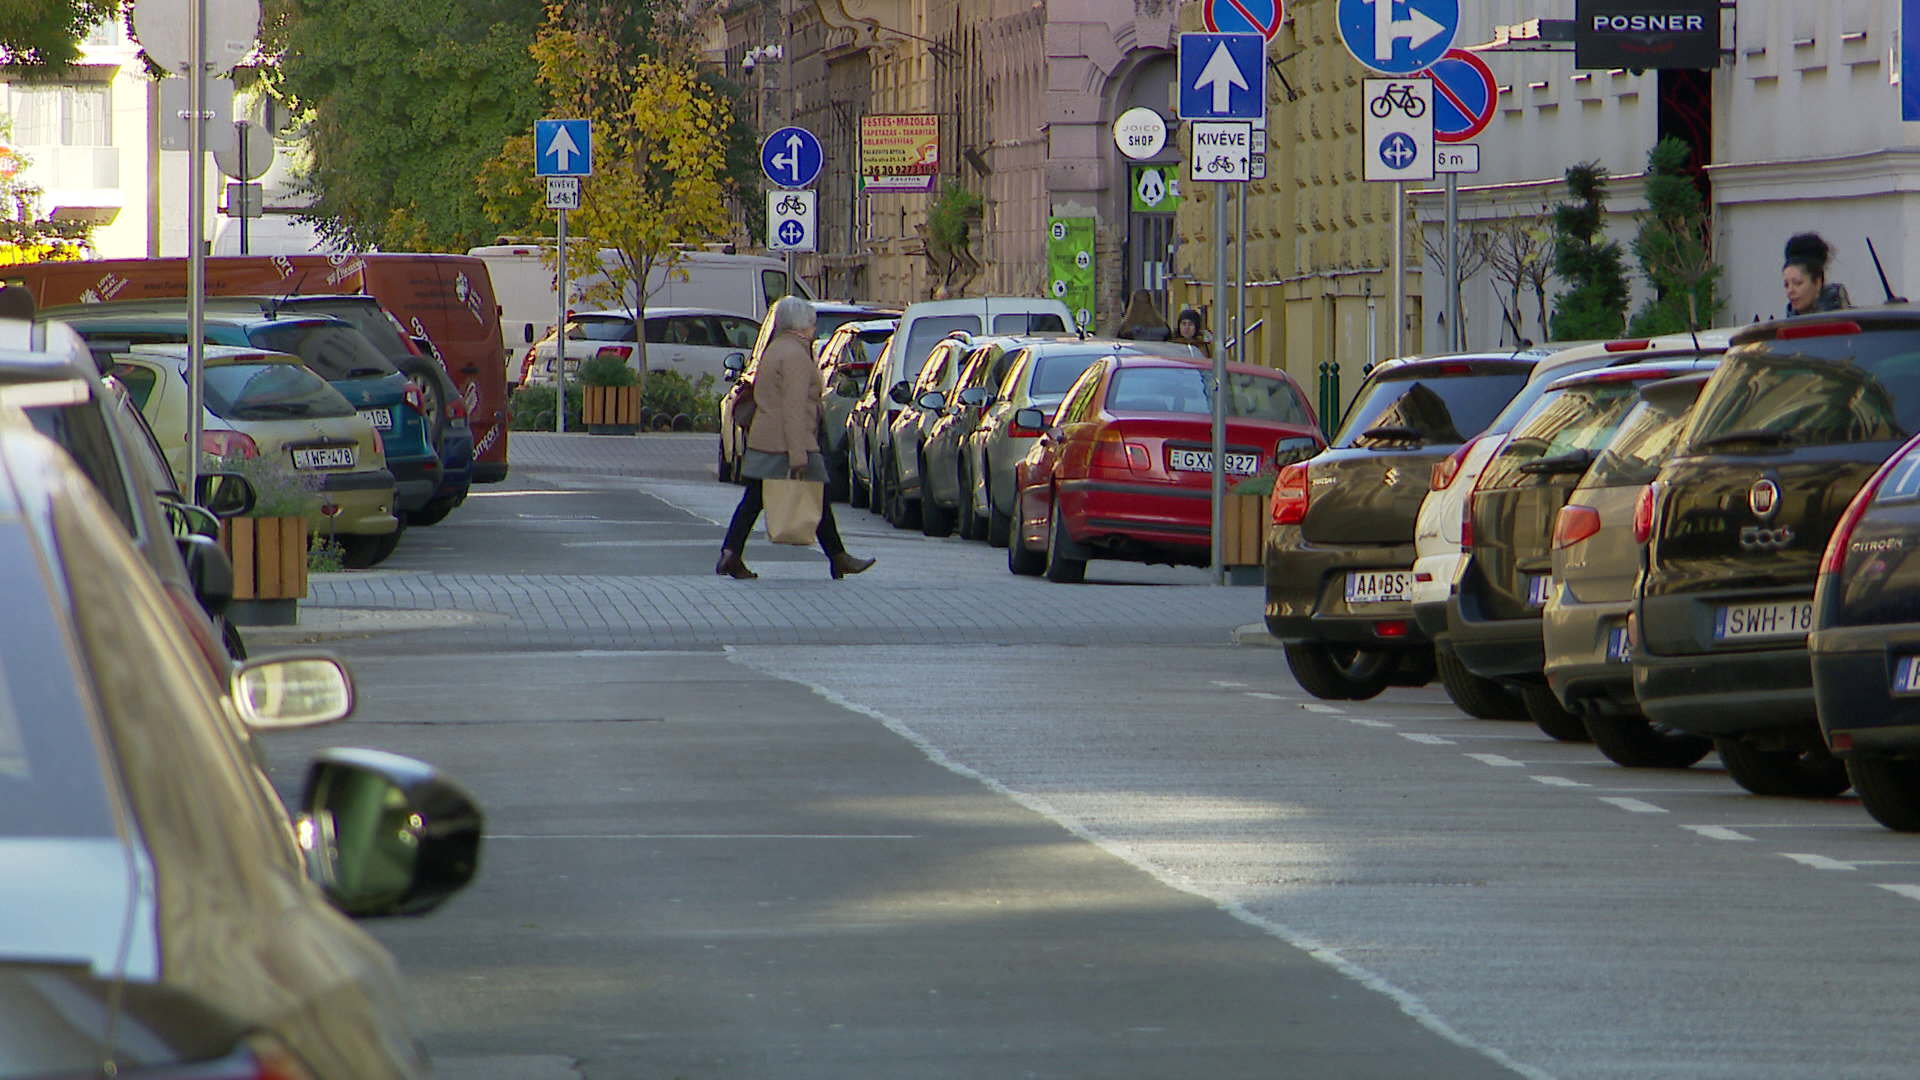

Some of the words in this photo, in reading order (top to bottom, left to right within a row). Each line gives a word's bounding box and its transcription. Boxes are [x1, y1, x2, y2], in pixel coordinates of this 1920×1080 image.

[1593, 15, 1703, 31] POSNER
[1122, 124, 1160, 132] JOICO
[1129, 135, 1153, 146] SHOP
[1198, 130, 1245, 145] KIVÉVE
[1450, 155, 1463, 165] m
[550, 180, 574, 188] KIVÉVE
[472, 423, 500, 461] omfort
[1357, 575, 1377, 595] AA
[1384, 573, 1413, 594] BS-
[1730, 604, 1812, 634] SWH-18
